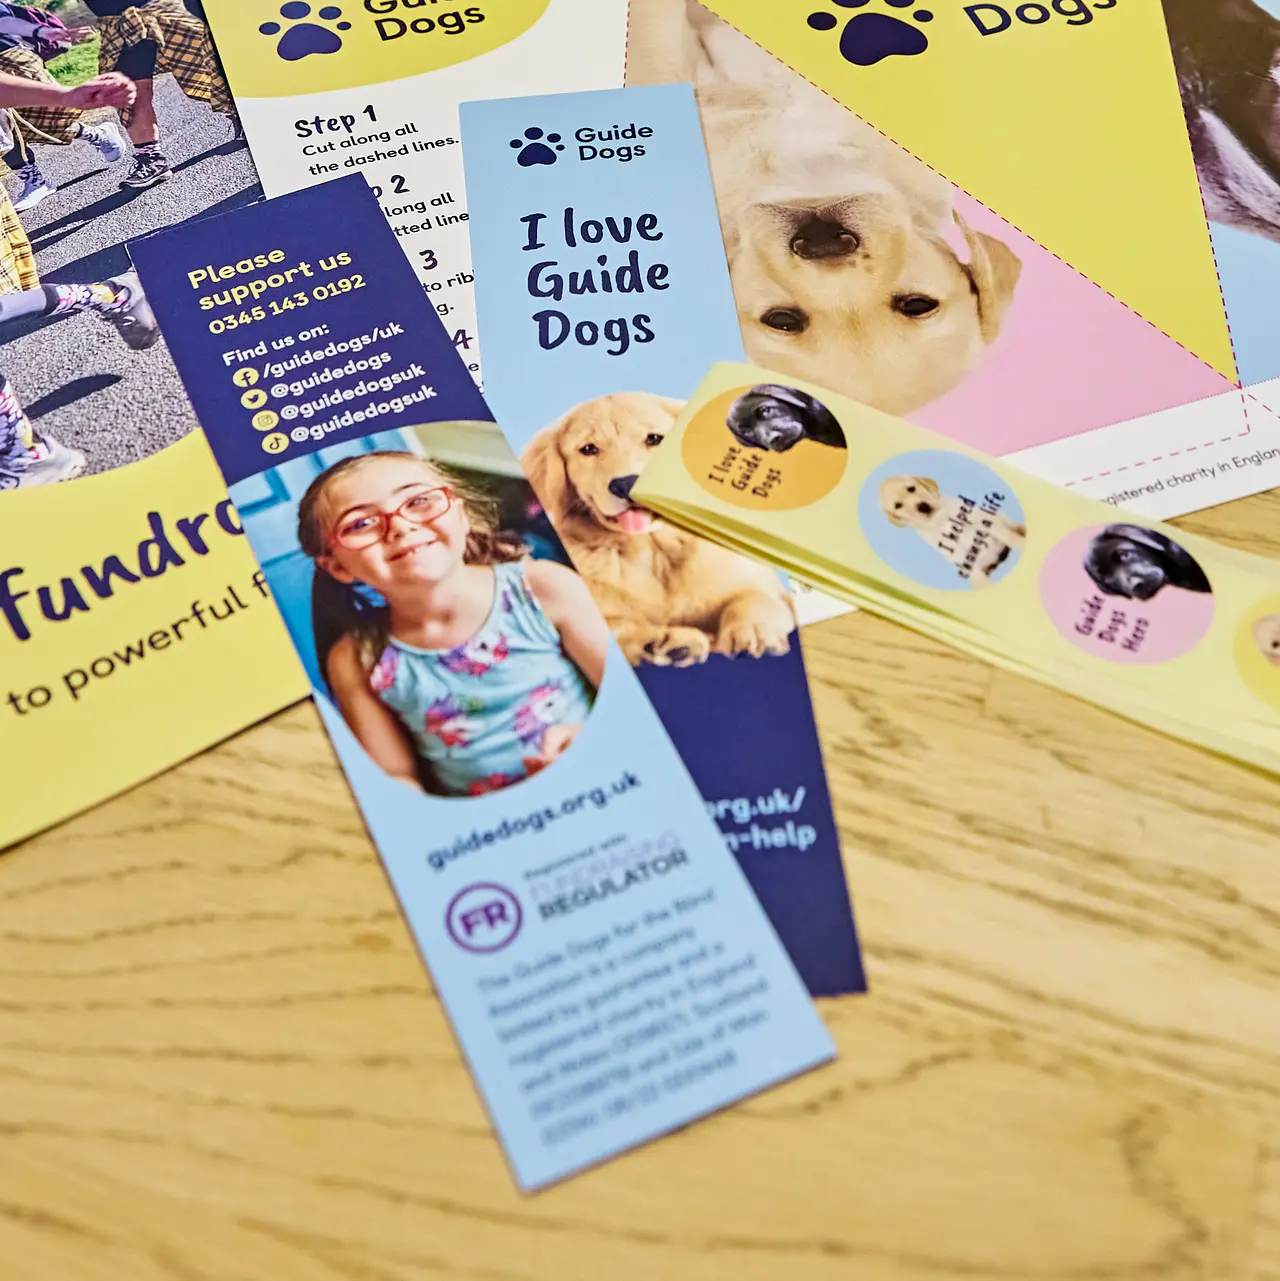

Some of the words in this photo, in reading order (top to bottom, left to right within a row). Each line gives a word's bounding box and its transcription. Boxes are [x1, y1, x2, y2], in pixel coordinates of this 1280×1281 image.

[374, 7, 485, 41] Dogs
[294, 113, 356, 138] Step
[363, 104, 377, 121] 1
[302, 141, 336, 157] Cut
[340, 128, 391, 149] along
[394, 123, 418, 137] all
[575, 124, 653, 142] Guide
[308, 162, 339, 176] the
[344, 144, 408, 168] dashed
[412, 135, 460, 152] lines.
[579, 143, 646, 162] Dogs
[385, 203, 427, 217] long
[431, 192, 455, 206] all
[391, 175, 410, 193] 2
[394, 218, 432, 236] tted
[436, 212, 470, 227] line
[520, 213, 547, 251] I
[564, 207, 663, 247] love
[187, 248, 286, 289] Please
[199, 261, 314, 310] support
[319, 249, 352, 271] us
[419, 249, 438, 270] 3
[527, 250, 670, 301] Guide
[423, 282, 442, 292] to
[447, 270, 474, 287] rib
[209, 307, 266, 335] 0345
[269, 292, 309, 317] 143
[312, 274, 366, 301] 0192
[222, 342, 268, 367] Find
[272, 335, 295, 351] us
[299, 324, 330, 341] on:
[263, 322, 404, 379] /guidedogs/uk
[453, 329, 474, 349] 4
[532, 310, 655, 356] Dogs
[271, 350, 391, 399] @guidedogs
[280, 363, 426, 420] @guidedogsuk
[290, 385, 437, 443] @guidedogsuk
[708, 473, 724, 484] I
[717, 446, 741, 472] love
[732, 454, 762, 491] Guide
[752, 468, 781, 498] Dogs
[1100, 481, 1164, 508] gistered
[1167, 467, 1217, 489] charity
[1218, 462, 1231, 472] in
[942, 495, 976, 541] helped
[955, 530, 989, 578] change
[979, 492, 1005, 516] life
[939, 541, 954, 554] I
[1075, 594, 1104, 636] Guide
[1098, 609, 1126, 643] Dogs
[6, 686, 51, 716] to
[63, 584, 250, 702] powerful
[427, 771, 641, 872] guidedogs.org.uk
[539, 848, 689, 921] REGULATOR
[459, 900, 509, 936] FR
